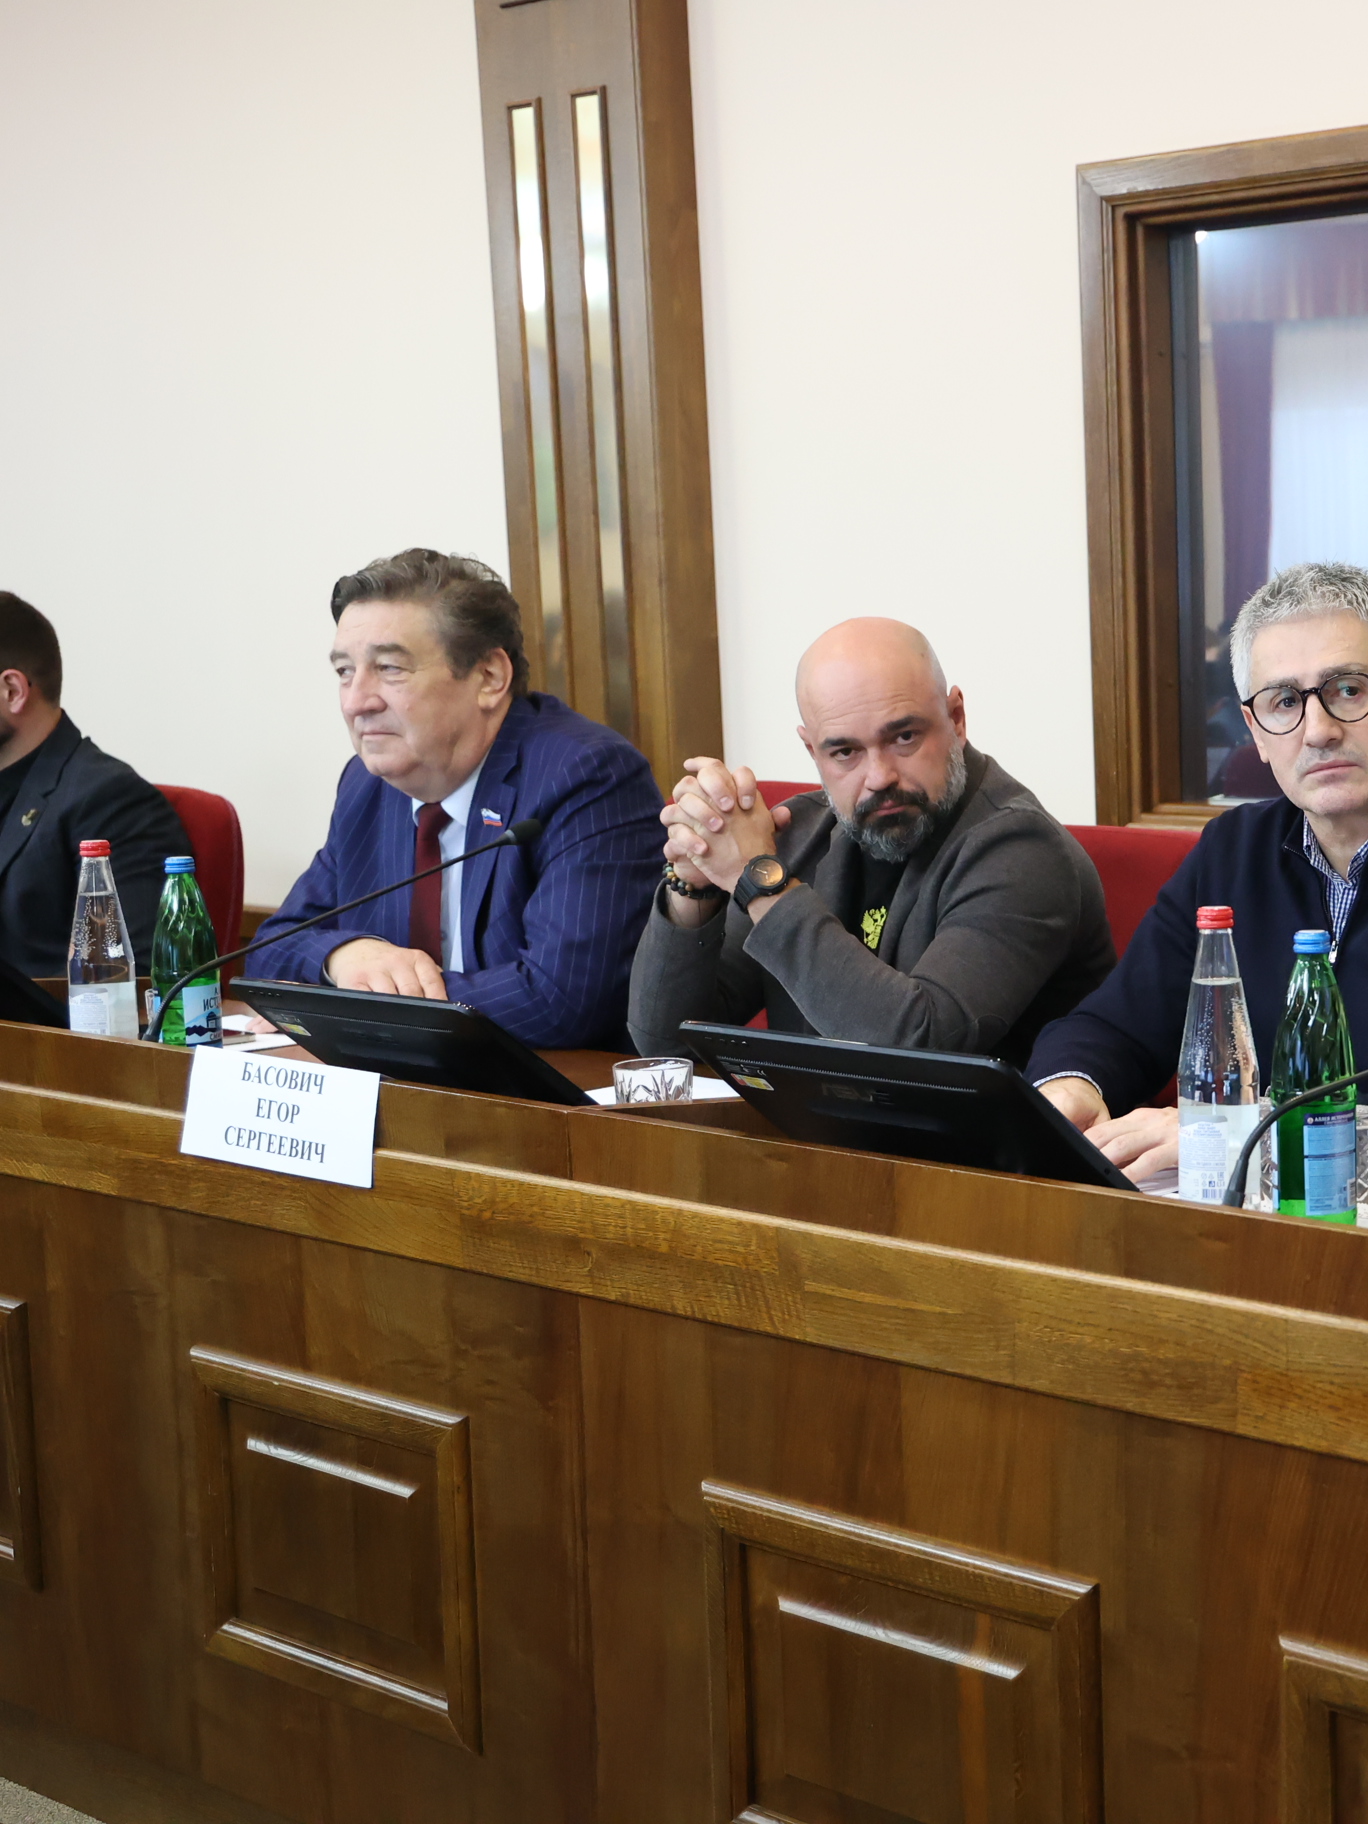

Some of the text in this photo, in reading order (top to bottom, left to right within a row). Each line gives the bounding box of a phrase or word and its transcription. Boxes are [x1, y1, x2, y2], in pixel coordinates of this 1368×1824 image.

[241, 1061, 326, 1095] БАСОВИЧ
[255, 1097, 301, 1124] ЕГОР
[224, 1125, 326, 1164] СЕРГЕЕВИЧ
